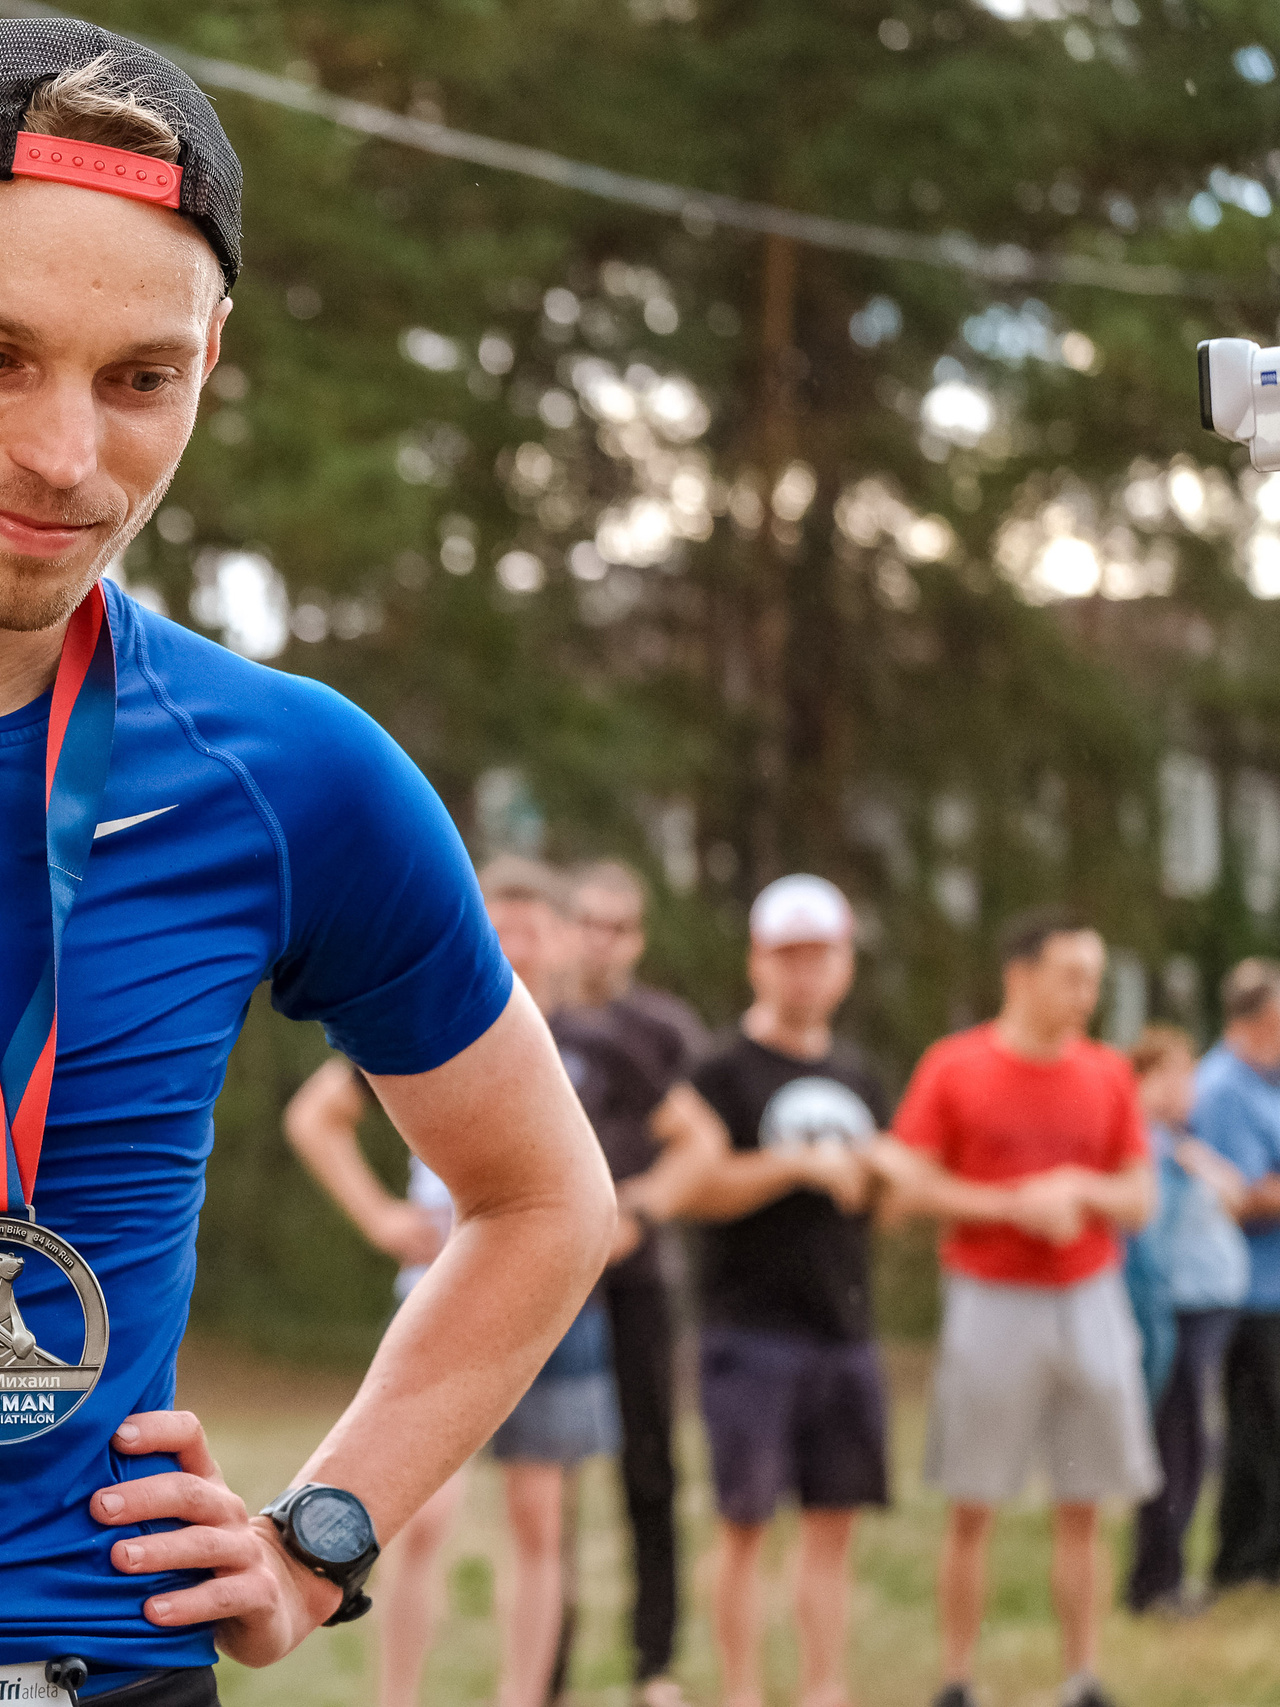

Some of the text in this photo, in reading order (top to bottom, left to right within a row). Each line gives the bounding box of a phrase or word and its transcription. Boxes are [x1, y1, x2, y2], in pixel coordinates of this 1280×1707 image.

[6, 1225, 27, 1237] Bike
[33, 1233, 46, 1244] 84
[45, 1239, 59, 1253] km
[58, 1250, 74, 1267] Run
